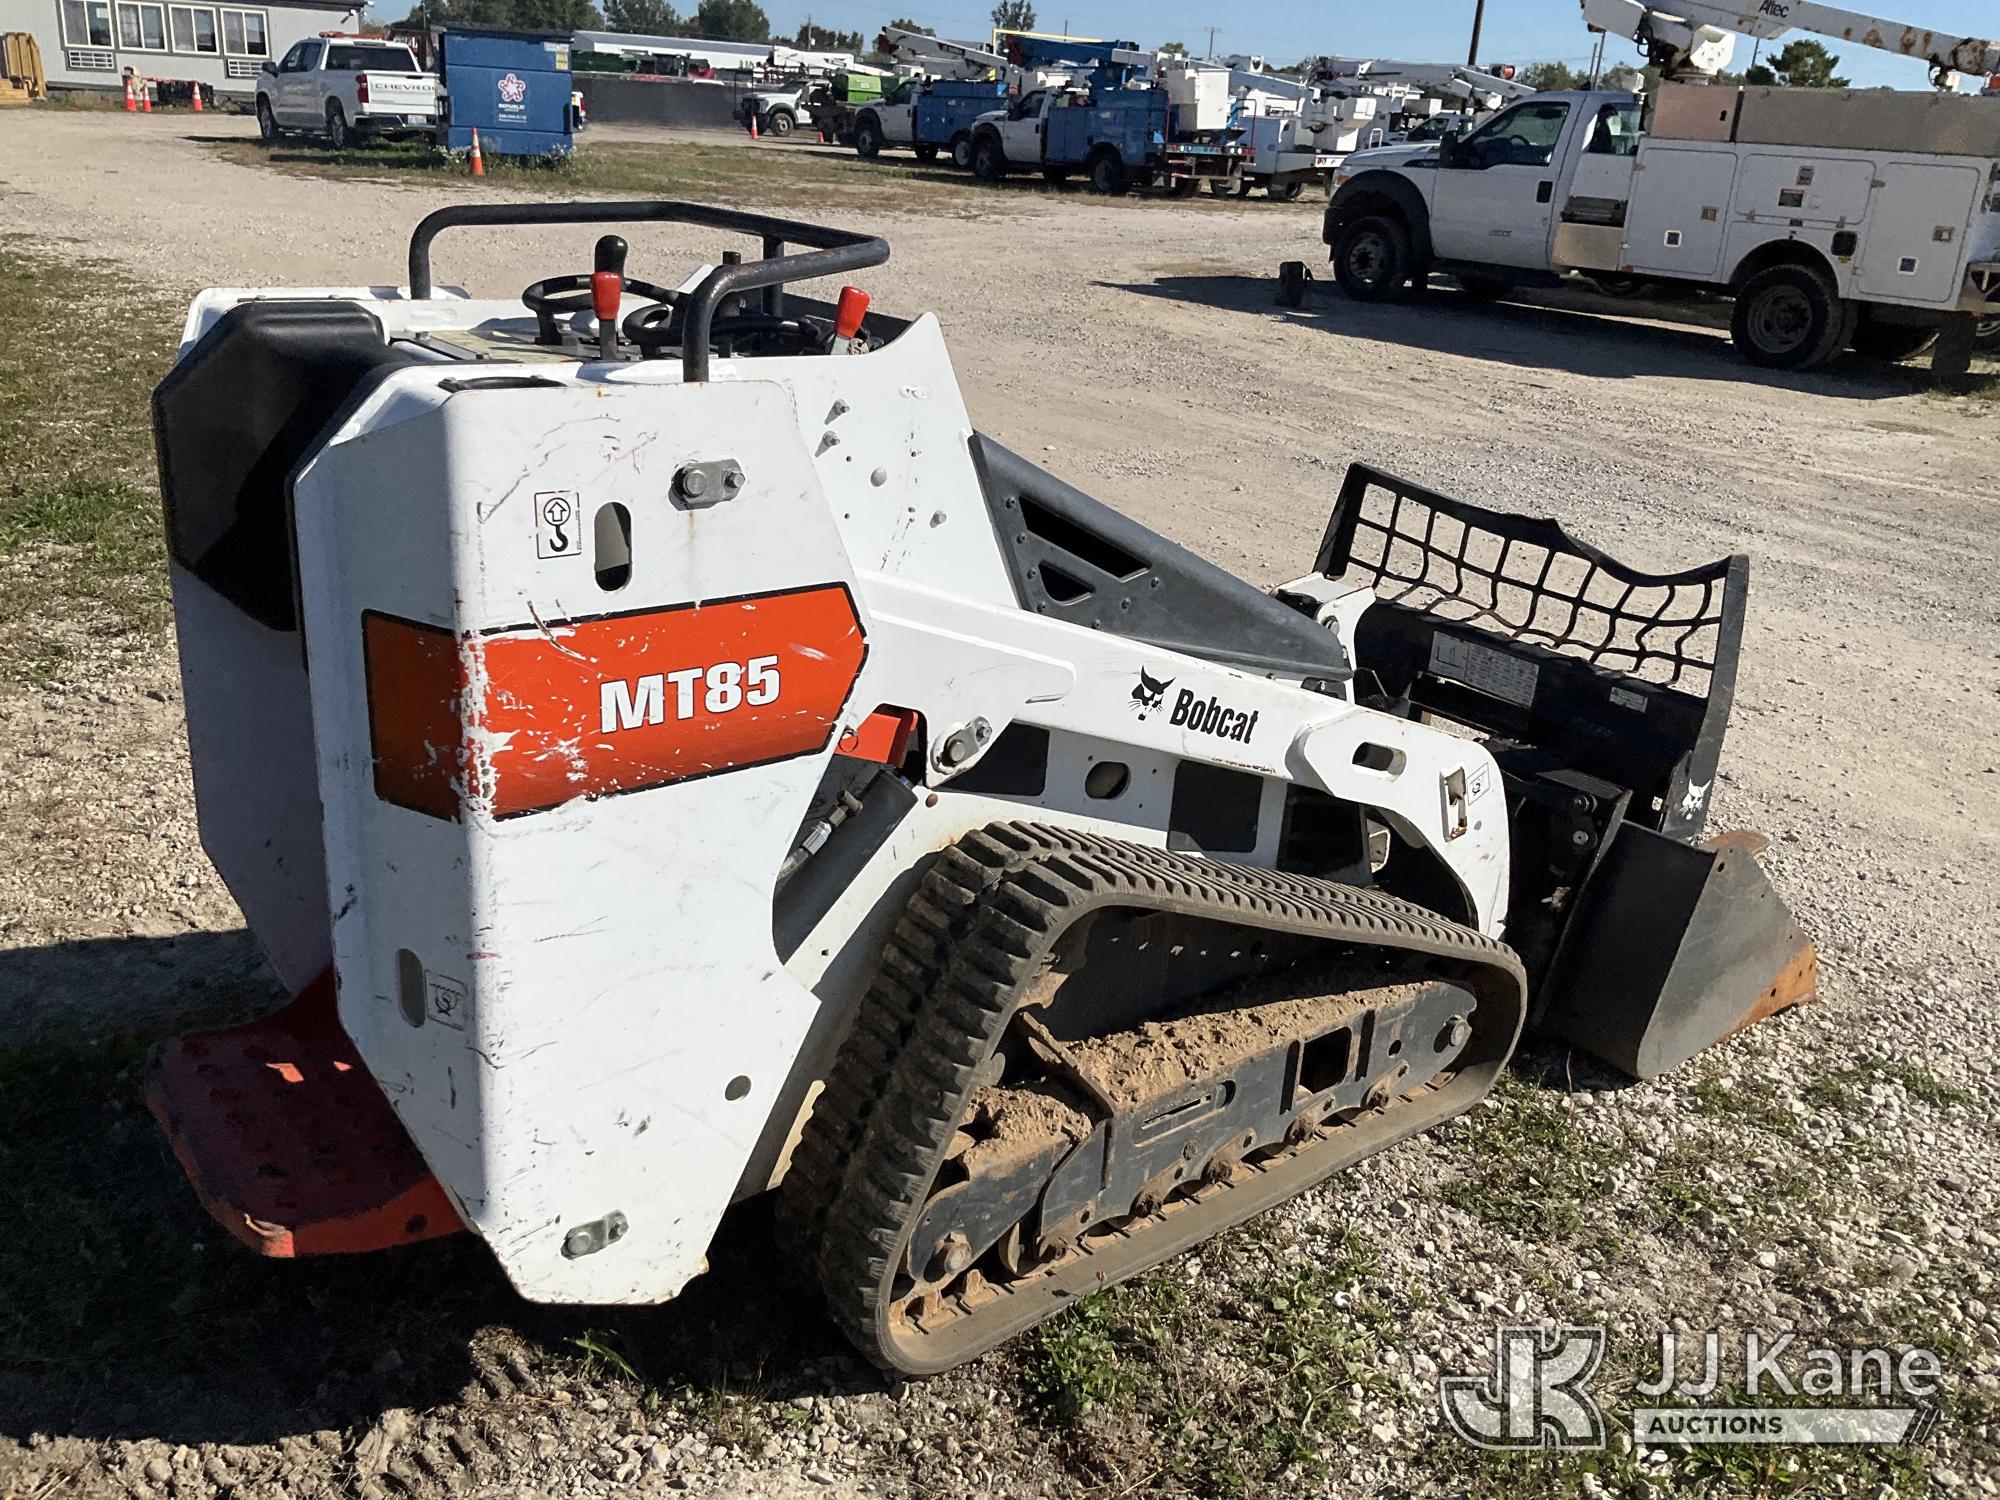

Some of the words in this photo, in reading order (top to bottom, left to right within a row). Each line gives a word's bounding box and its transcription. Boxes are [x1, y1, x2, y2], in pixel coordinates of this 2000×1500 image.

[1758, 0, 1789, 18] Altec
[375, 83, 435, 91] CHEVRO
[600, 654, 781, 734] MT85
[1169, 688, 1259, 744] Bobcat
